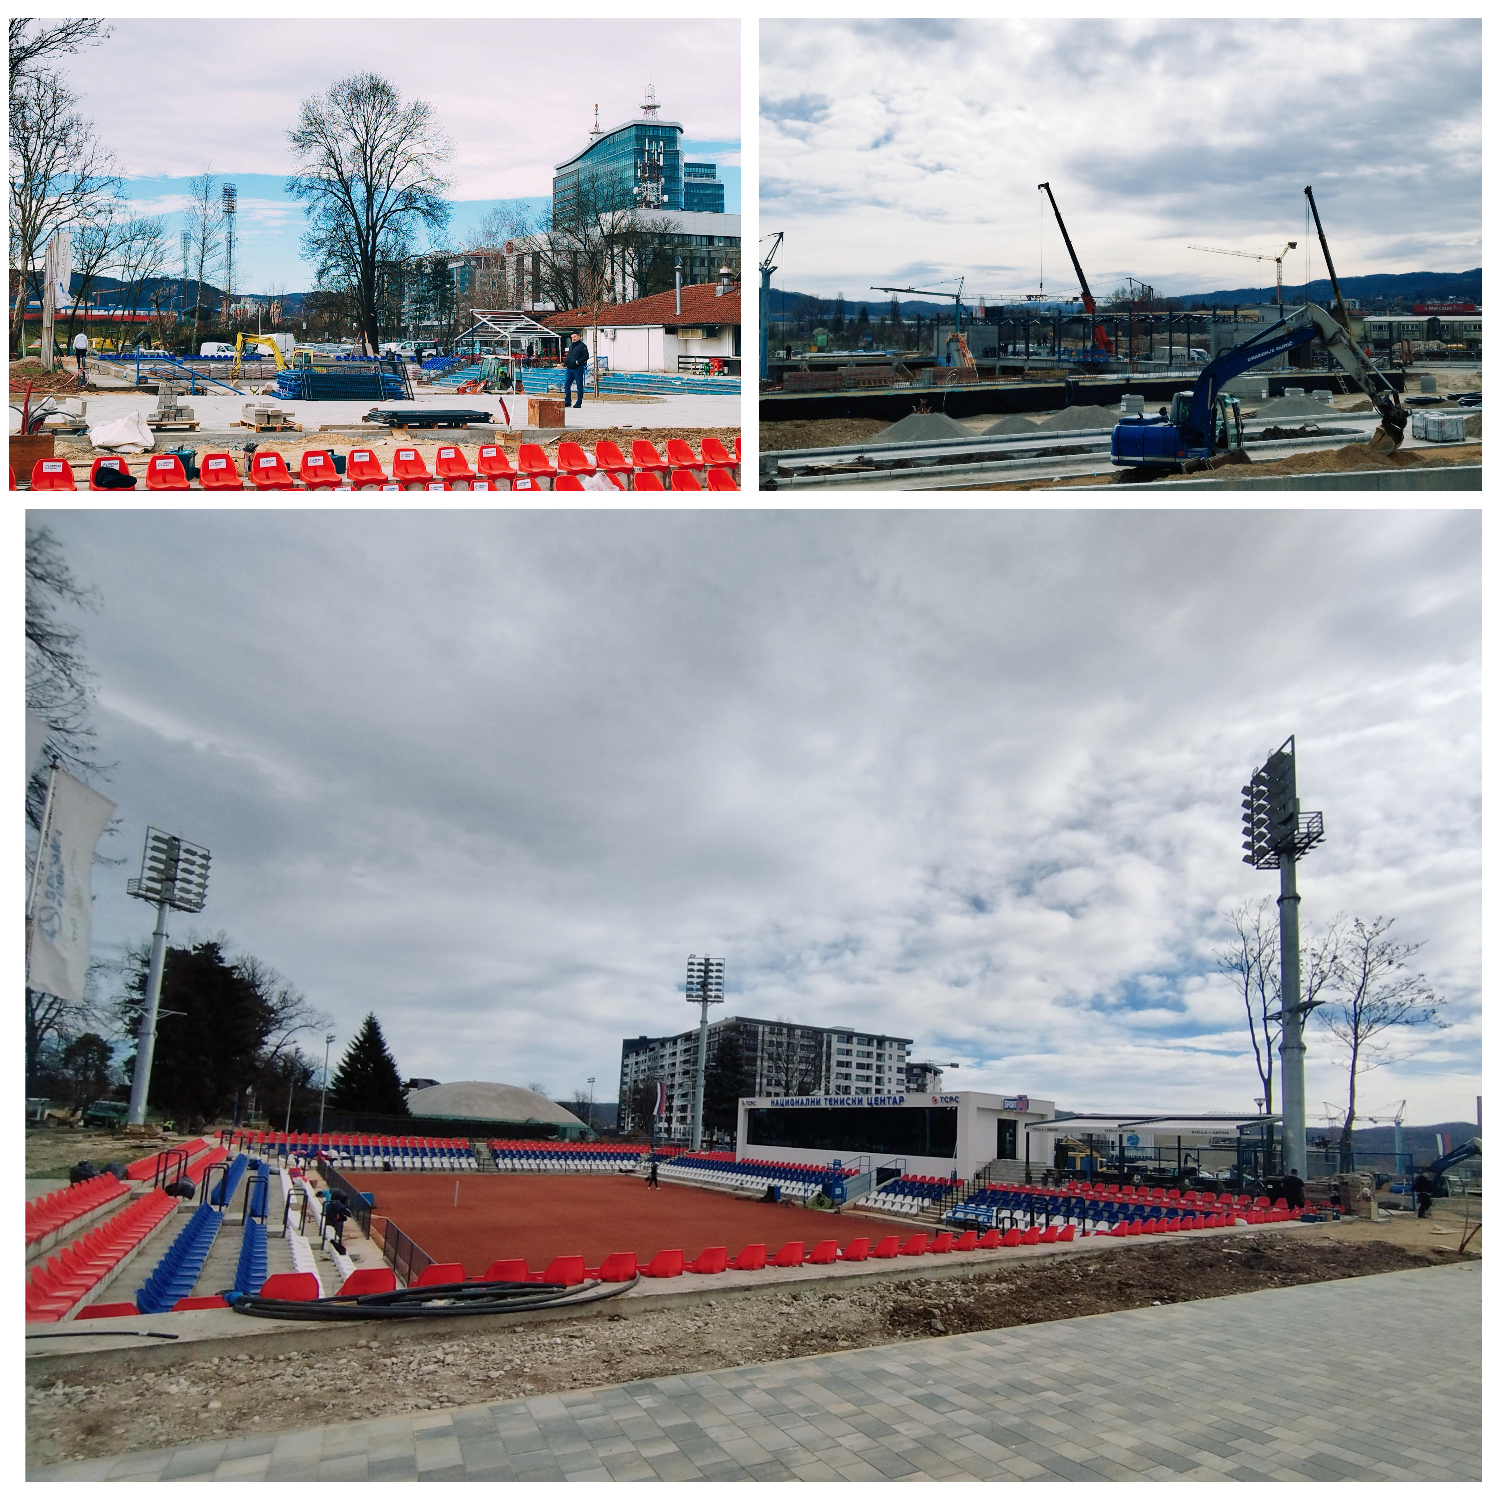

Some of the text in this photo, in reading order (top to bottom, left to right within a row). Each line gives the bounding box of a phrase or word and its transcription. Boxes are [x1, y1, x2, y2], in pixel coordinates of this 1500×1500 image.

[770, 1096, 905, 1107] НАЦИОНАЛНИ ТЕНИСКИ ЦЕНТАР
